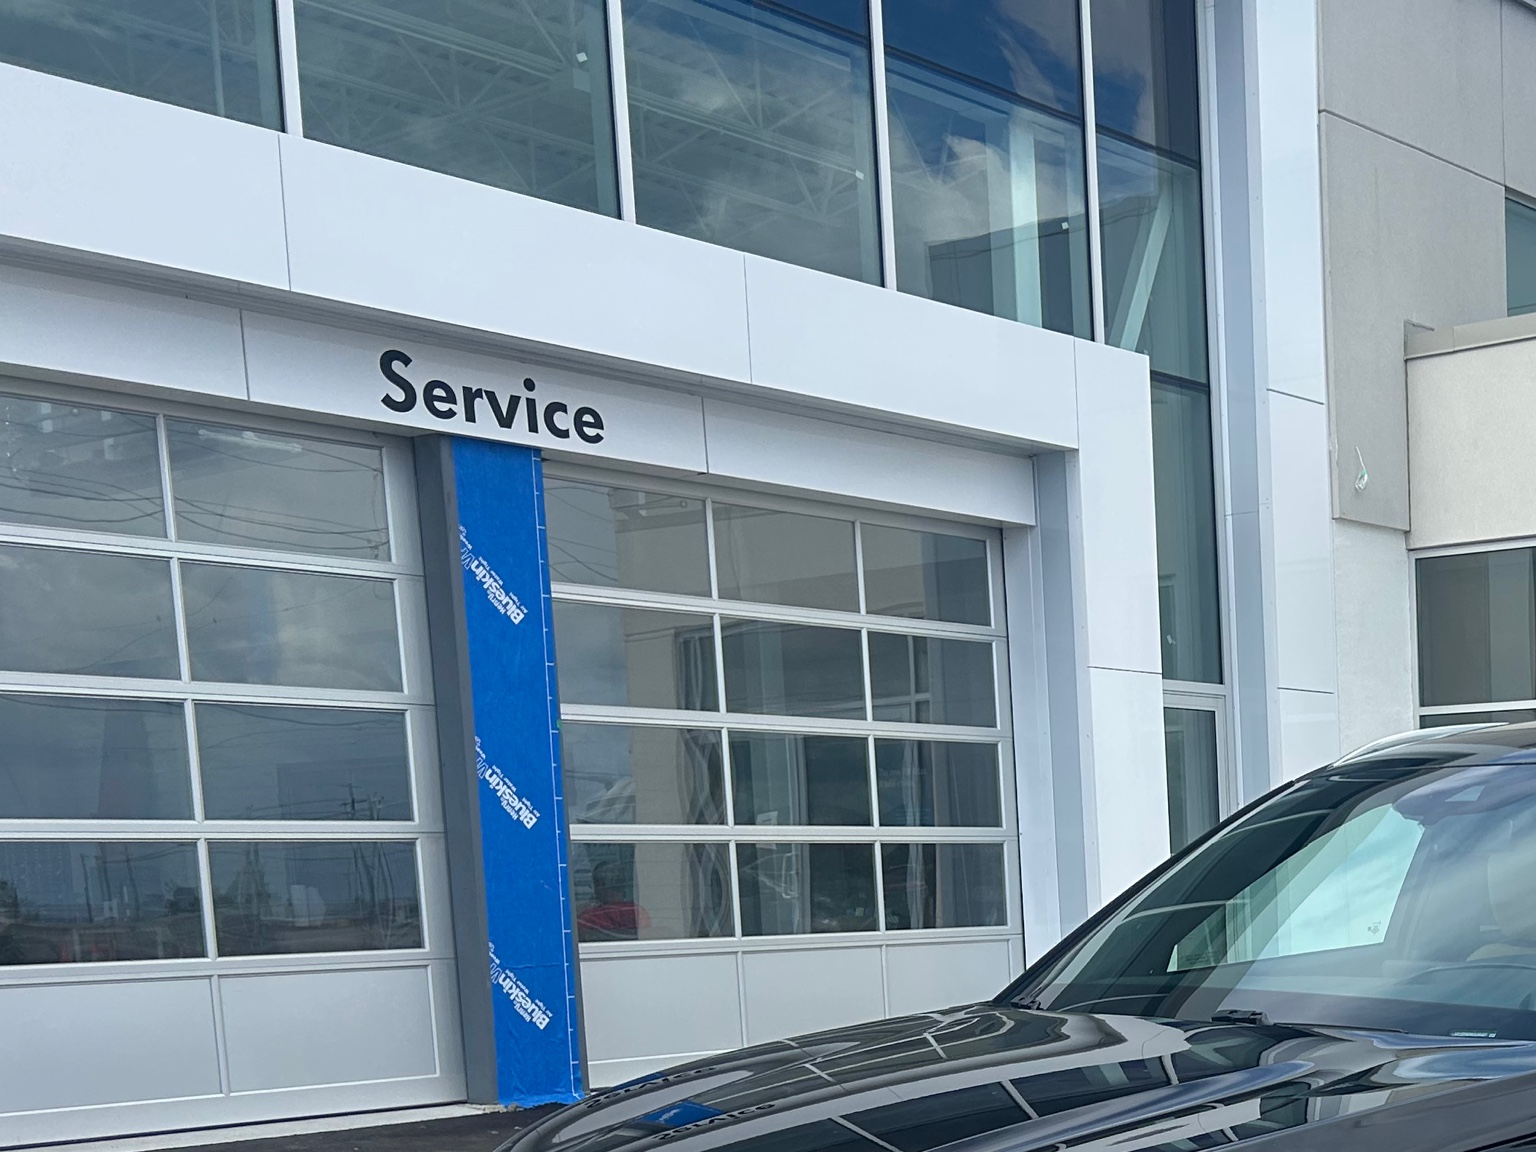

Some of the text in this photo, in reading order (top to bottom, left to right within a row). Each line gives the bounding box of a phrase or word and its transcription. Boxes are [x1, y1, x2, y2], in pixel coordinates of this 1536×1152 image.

[379, 349, 605, 444] Service
[469, 559, 525, 625] Blueskin
[481, 769, 537, 829] Blueskin
[495, 971, 549, 1029] Blueskin
